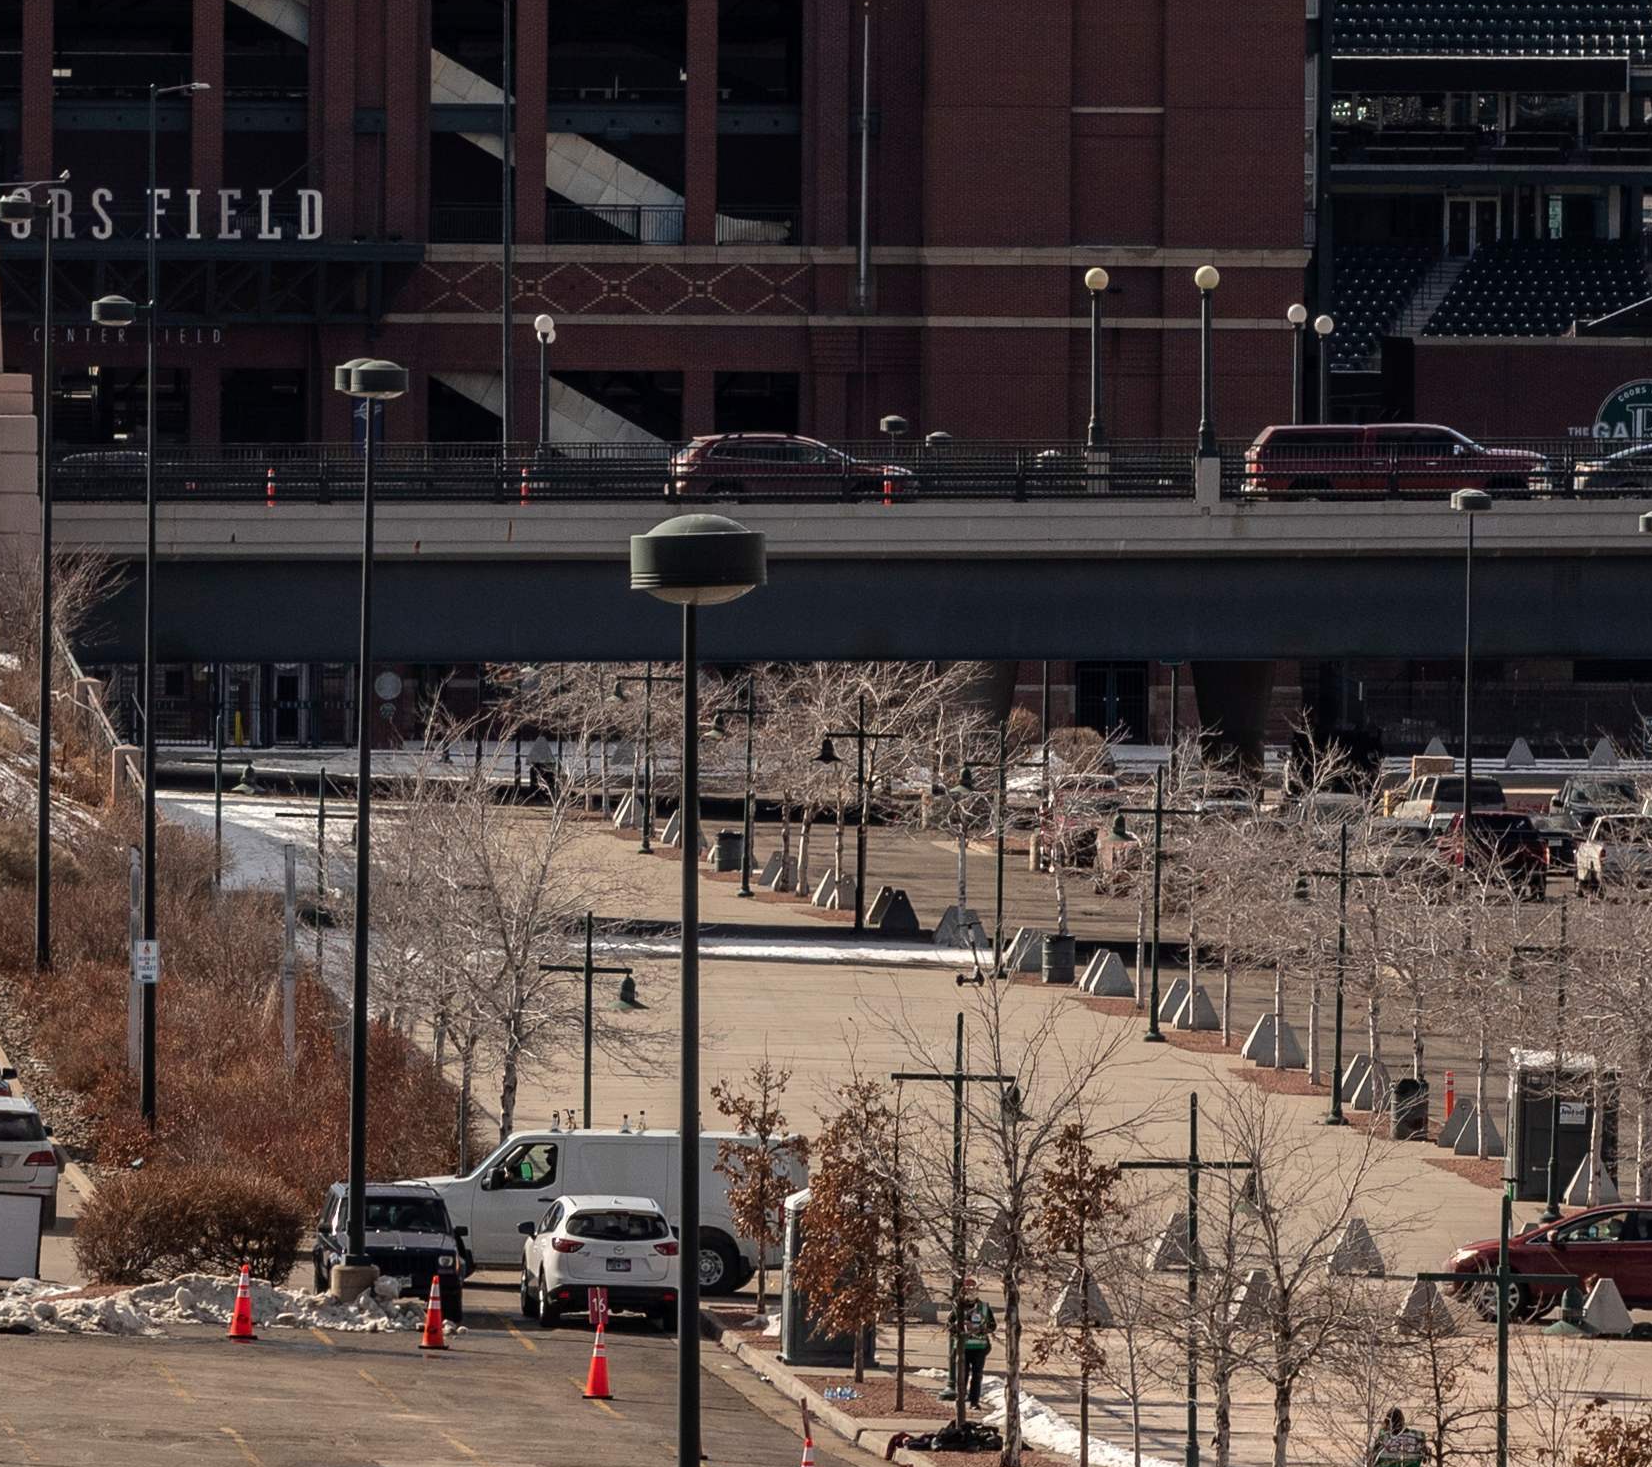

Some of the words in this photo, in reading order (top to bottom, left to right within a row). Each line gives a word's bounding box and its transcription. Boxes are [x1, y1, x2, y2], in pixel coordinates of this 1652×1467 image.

[146, 188, 323, 240] FIELD
[1617, 386, 1647, 402] COORS
[1568, 427, 1589, 437] THE
